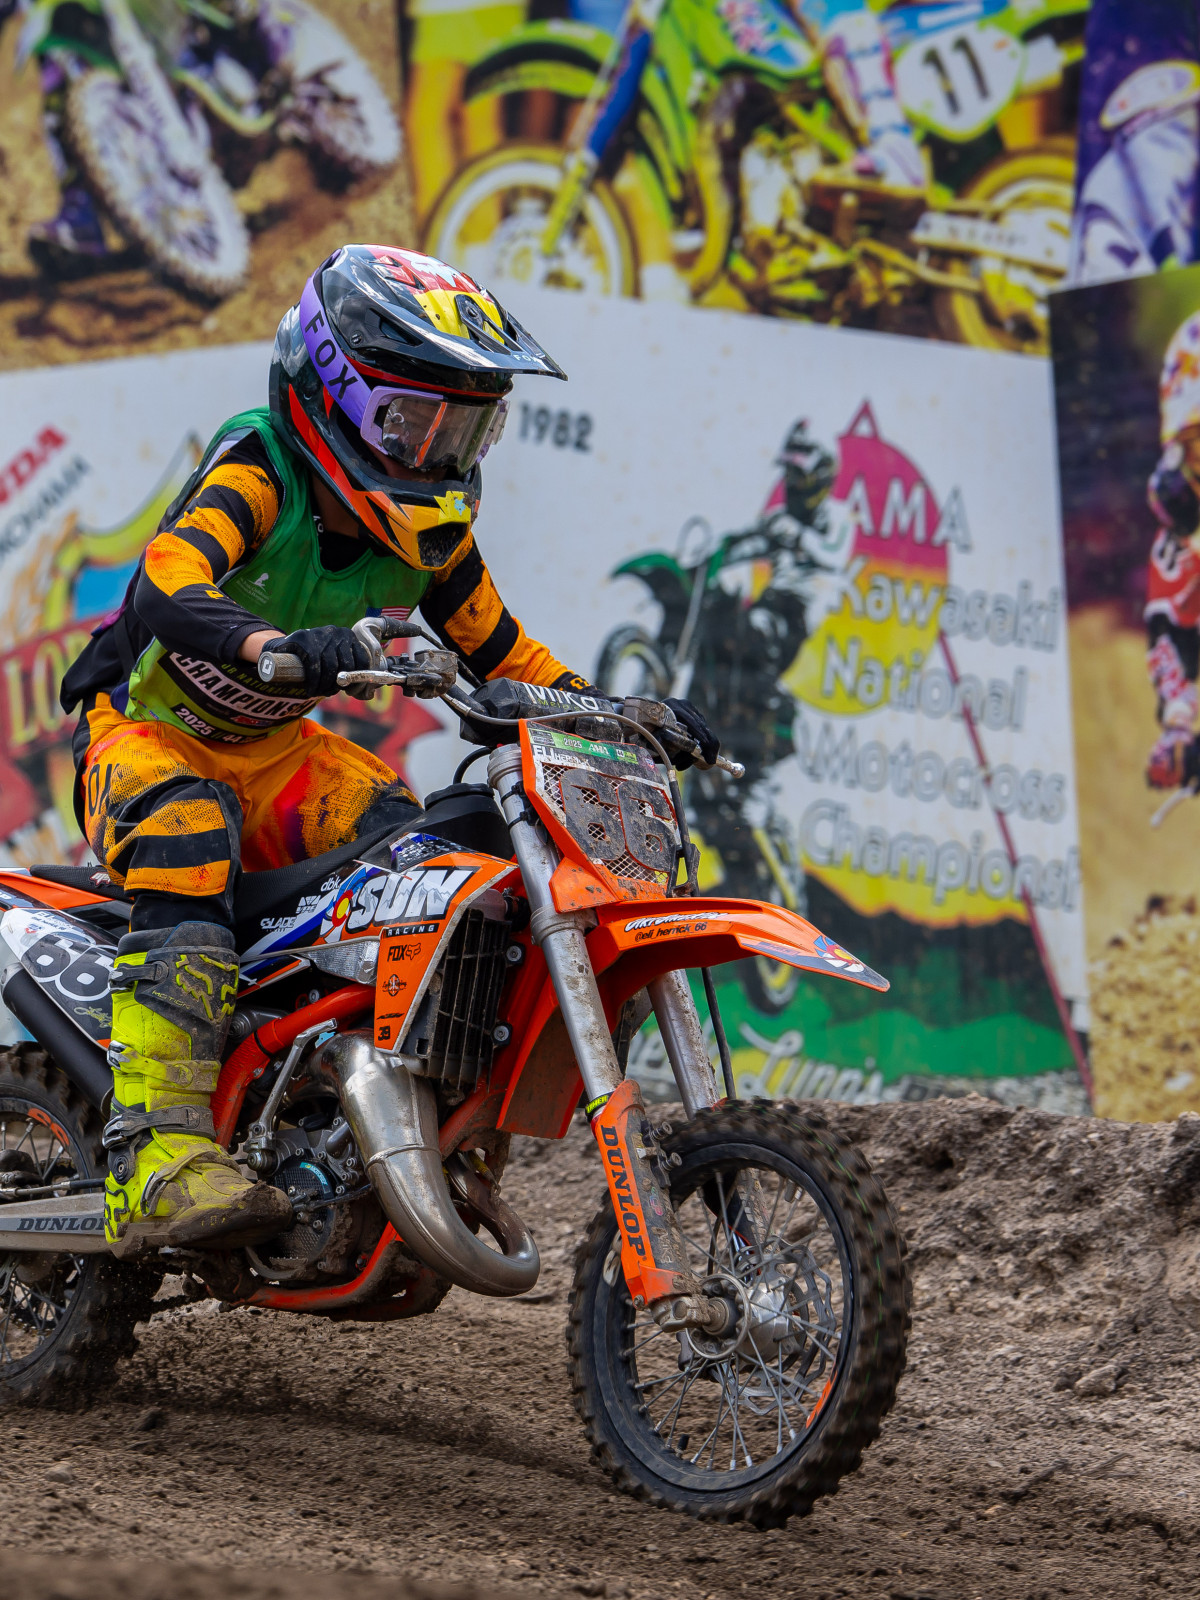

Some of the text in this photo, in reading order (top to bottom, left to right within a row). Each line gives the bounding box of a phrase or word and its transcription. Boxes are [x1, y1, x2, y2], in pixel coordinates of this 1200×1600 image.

[305, 310, 356, 400] FOX
[517, 401, 593, 453] 1982
[847, 473, 972, 552] AMA
[833, 554, 1061, 654] Kawasaki
[175, 706, 216, 736] 2025
[820, 633, 1030, 733] National
[797, 719, 1068, 825] Motocross
[347, 869, 475, 931] SUN
[387, 924, 436, 937] RACING
[387, 944, 407, 962] FOX
[600, 1124, 647, 1258] DUNLOP
